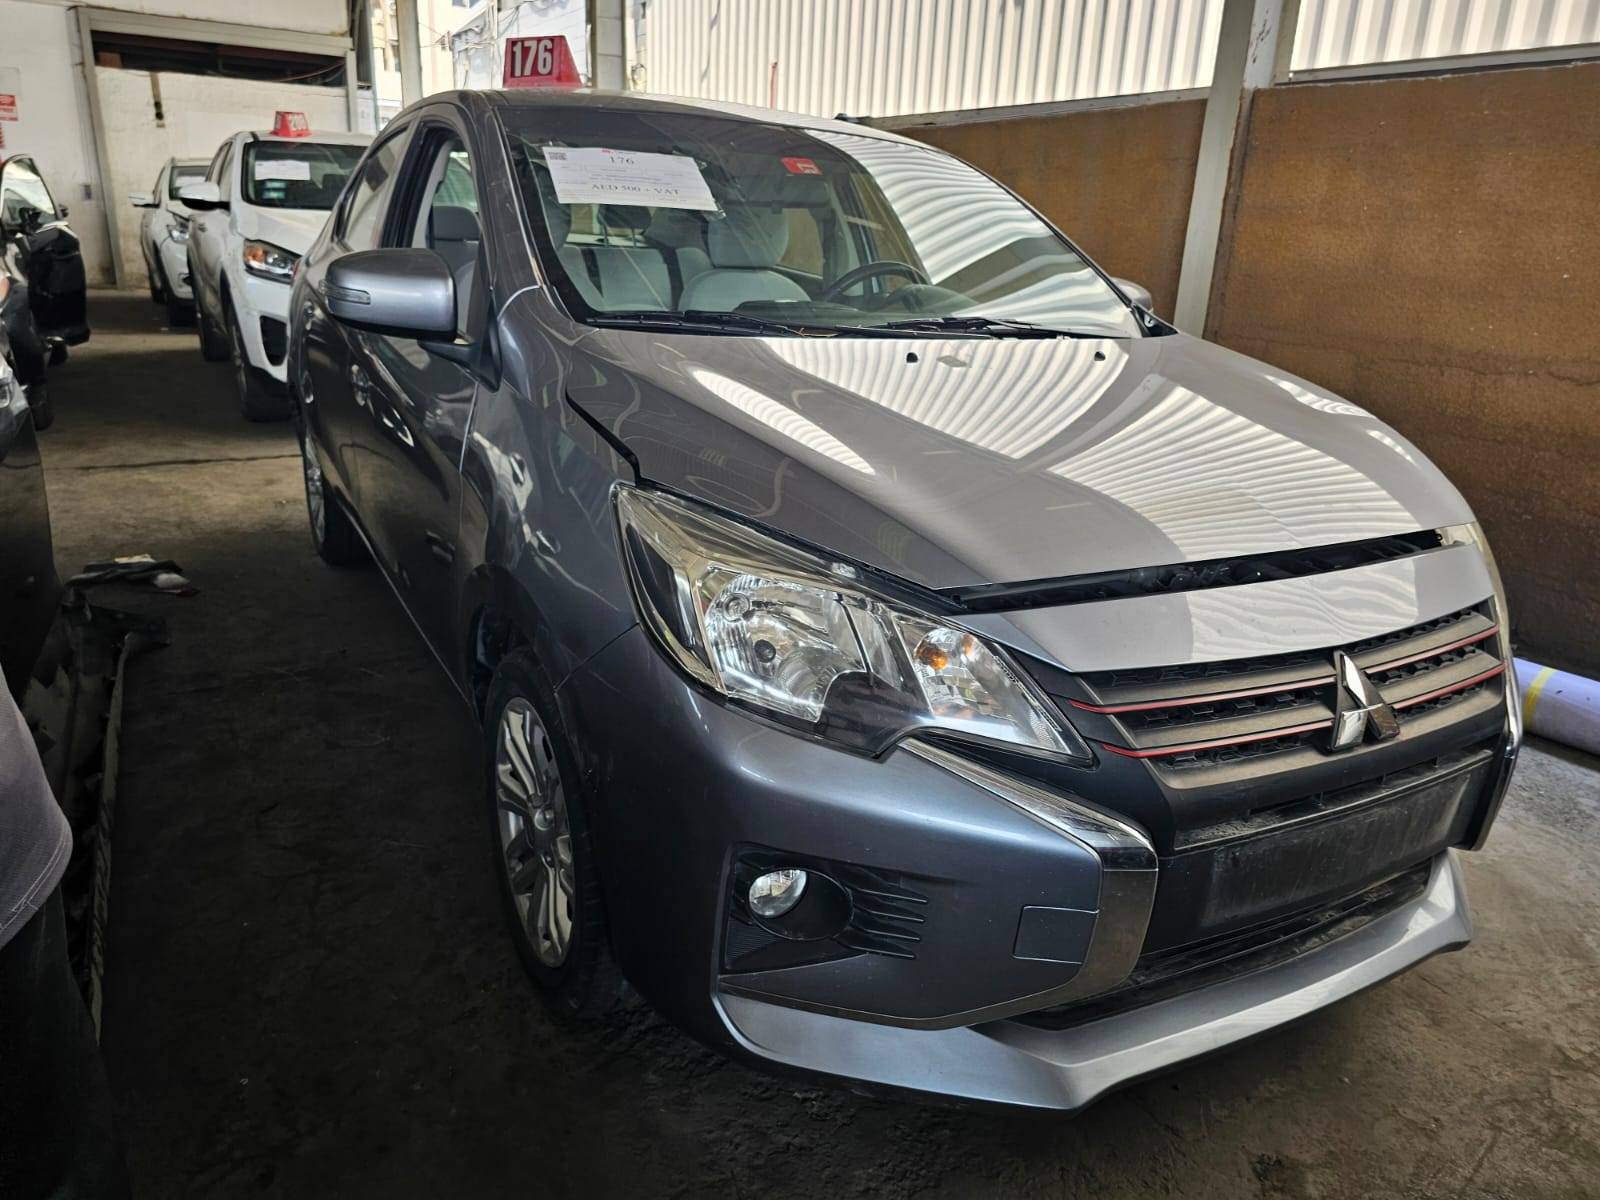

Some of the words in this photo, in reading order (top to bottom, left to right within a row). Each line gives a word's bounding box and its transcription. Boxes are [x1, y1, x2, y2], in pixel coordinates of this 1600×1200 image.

[512, 39, 553, 77] 176
[610, 156, 635, 165] 176
[621, 184, 641, 192] 500
[653, 186, 680, 195] VAT
